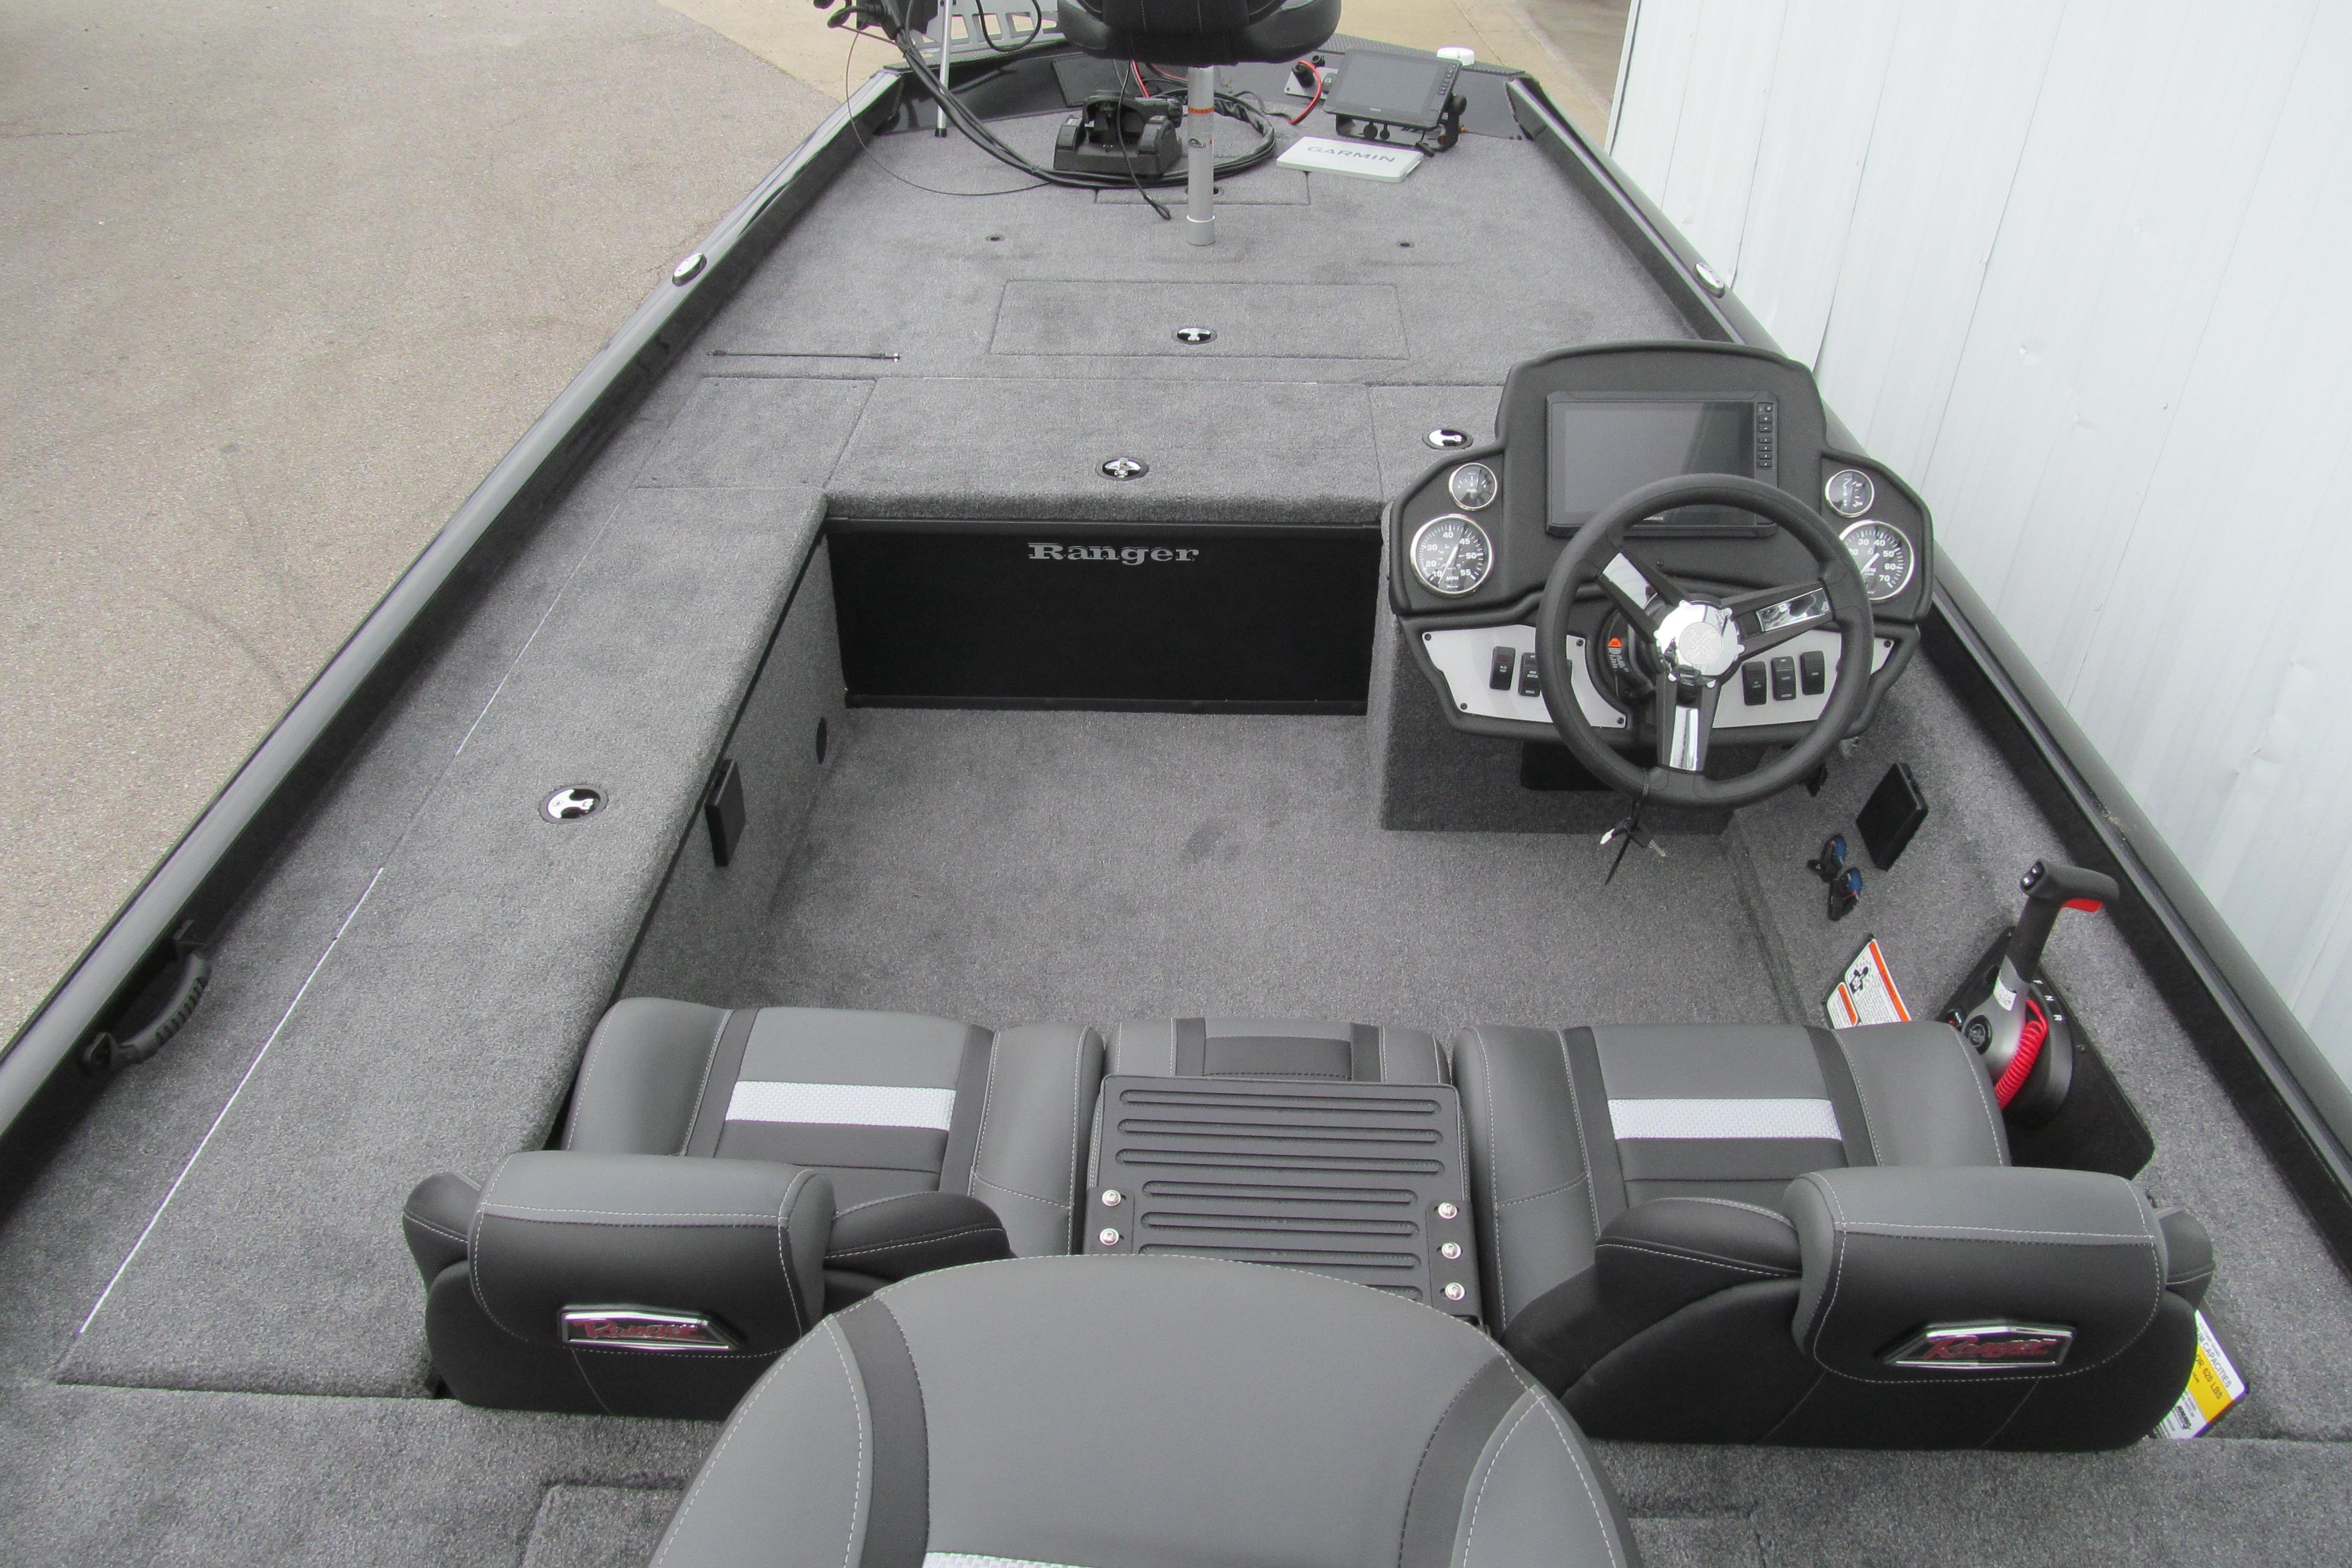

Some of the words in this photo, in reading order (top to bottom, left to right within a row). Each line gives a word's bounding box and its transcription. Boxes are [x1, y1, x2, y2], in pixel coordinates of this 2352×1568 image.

[1308, 146, 1395, 162] GARMIN
[1028, 542, 1199, 566] Ranger
[2202, 1343, 2232, 1388] CAPACITIES
[2210, 1382, 2223, 1400] LBS
